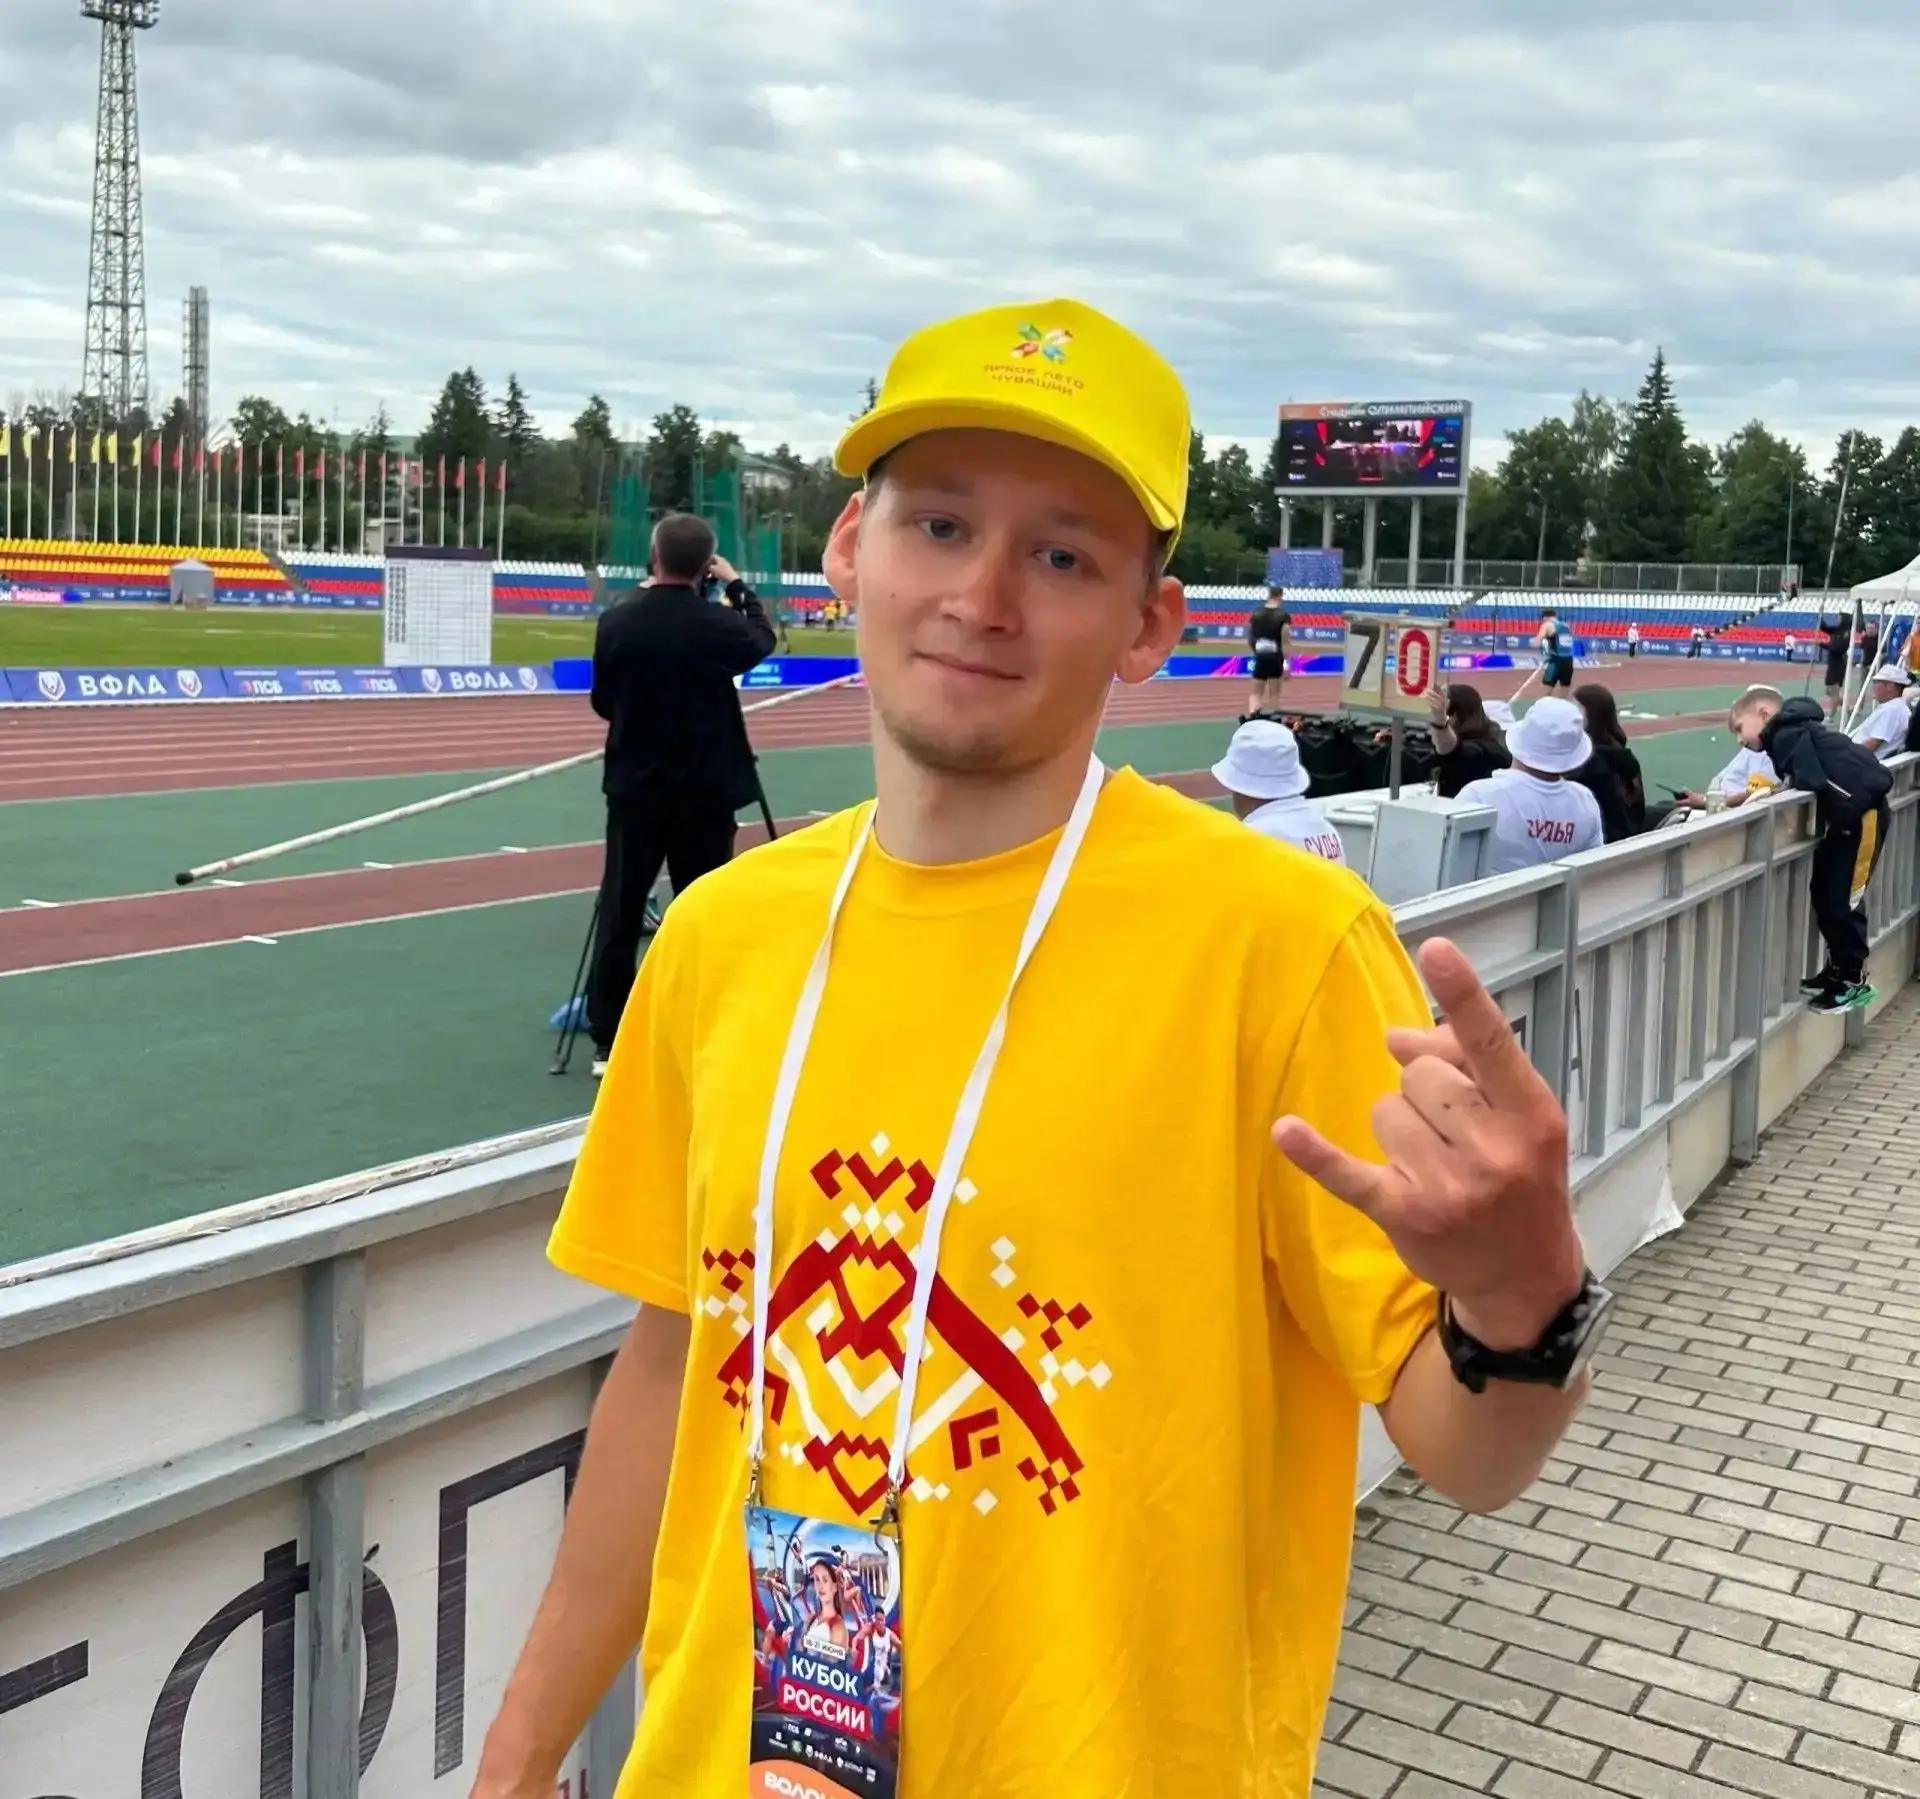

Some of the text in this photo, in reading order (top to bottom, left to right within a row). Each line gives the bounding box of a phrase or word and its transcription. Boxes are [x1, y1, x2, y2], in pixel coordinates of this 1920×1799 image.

[991, 374, 1073, 396] ЧУВАШИИ
[1044, 371, 1084, 390] ЛЕТО
[78, 674, 167, 696] ВФЛА
[252, 679, 283, 694] ПСБ
[313, 679, 342, 693] ПСБ
[369, 678, 398, 692] ПСБ
[449, 671, 513, 690] ВФЛА
[1526, 819, 1575, 843] СУДЬЯ
[791, 1654, 859, 1697] КУБОК
[782, 1683, 866, 1733] РОССИИ
